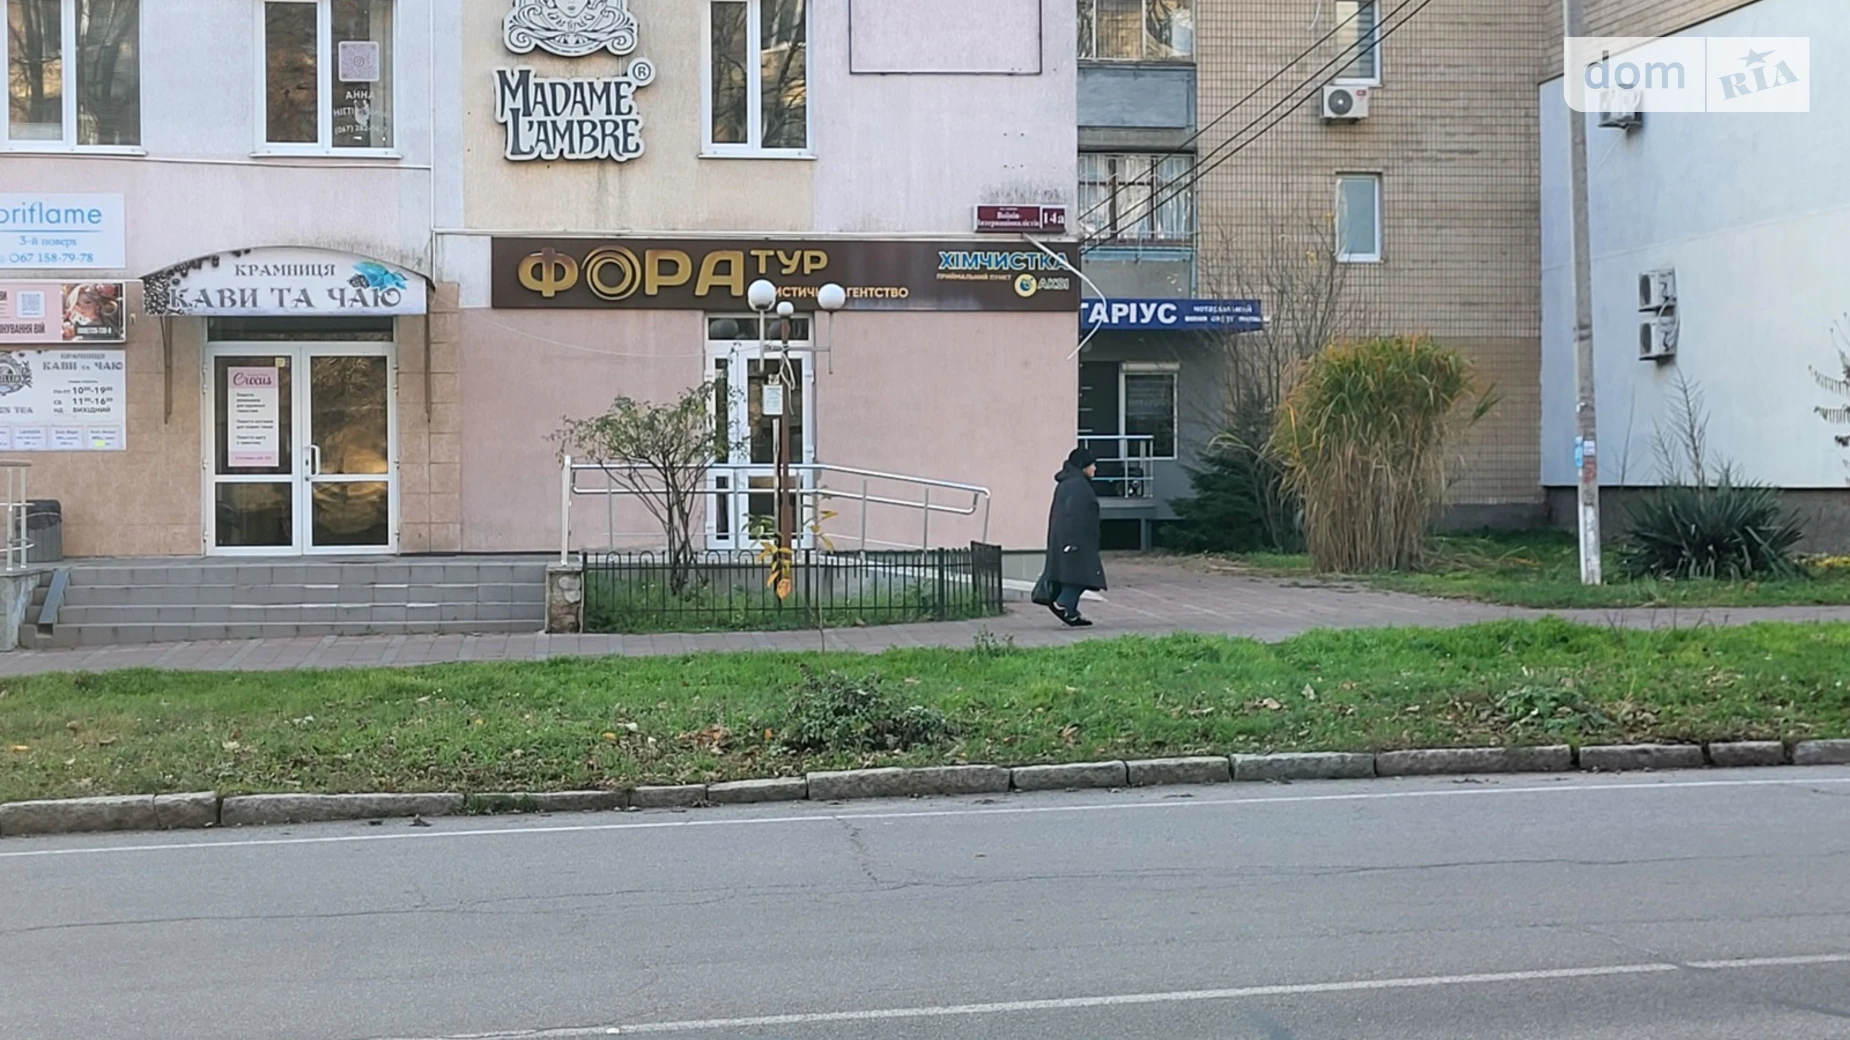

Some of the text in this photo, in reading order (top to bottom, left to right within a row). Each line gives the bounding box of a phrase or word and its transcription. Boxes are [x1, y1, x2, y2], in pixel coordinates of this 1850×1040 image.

[345, 91, 375, 100] АННА
[496, 69, 633, 117] MADAME
[0, 201, 102, 225] oriflame
[234, 264, 336, 277] КРАМНИЦЯ
[938, 251, 1070, 271] ХІМЧИСТКА
[517, 246, 829, 301] ФОРА ТУР
[169, 286, 404, 309] КАВИ ТА ЧАЮ
[846, 286, 909, 298] ГЕНТСТВО
[94, 361, 123, 370] ЧАЮ
